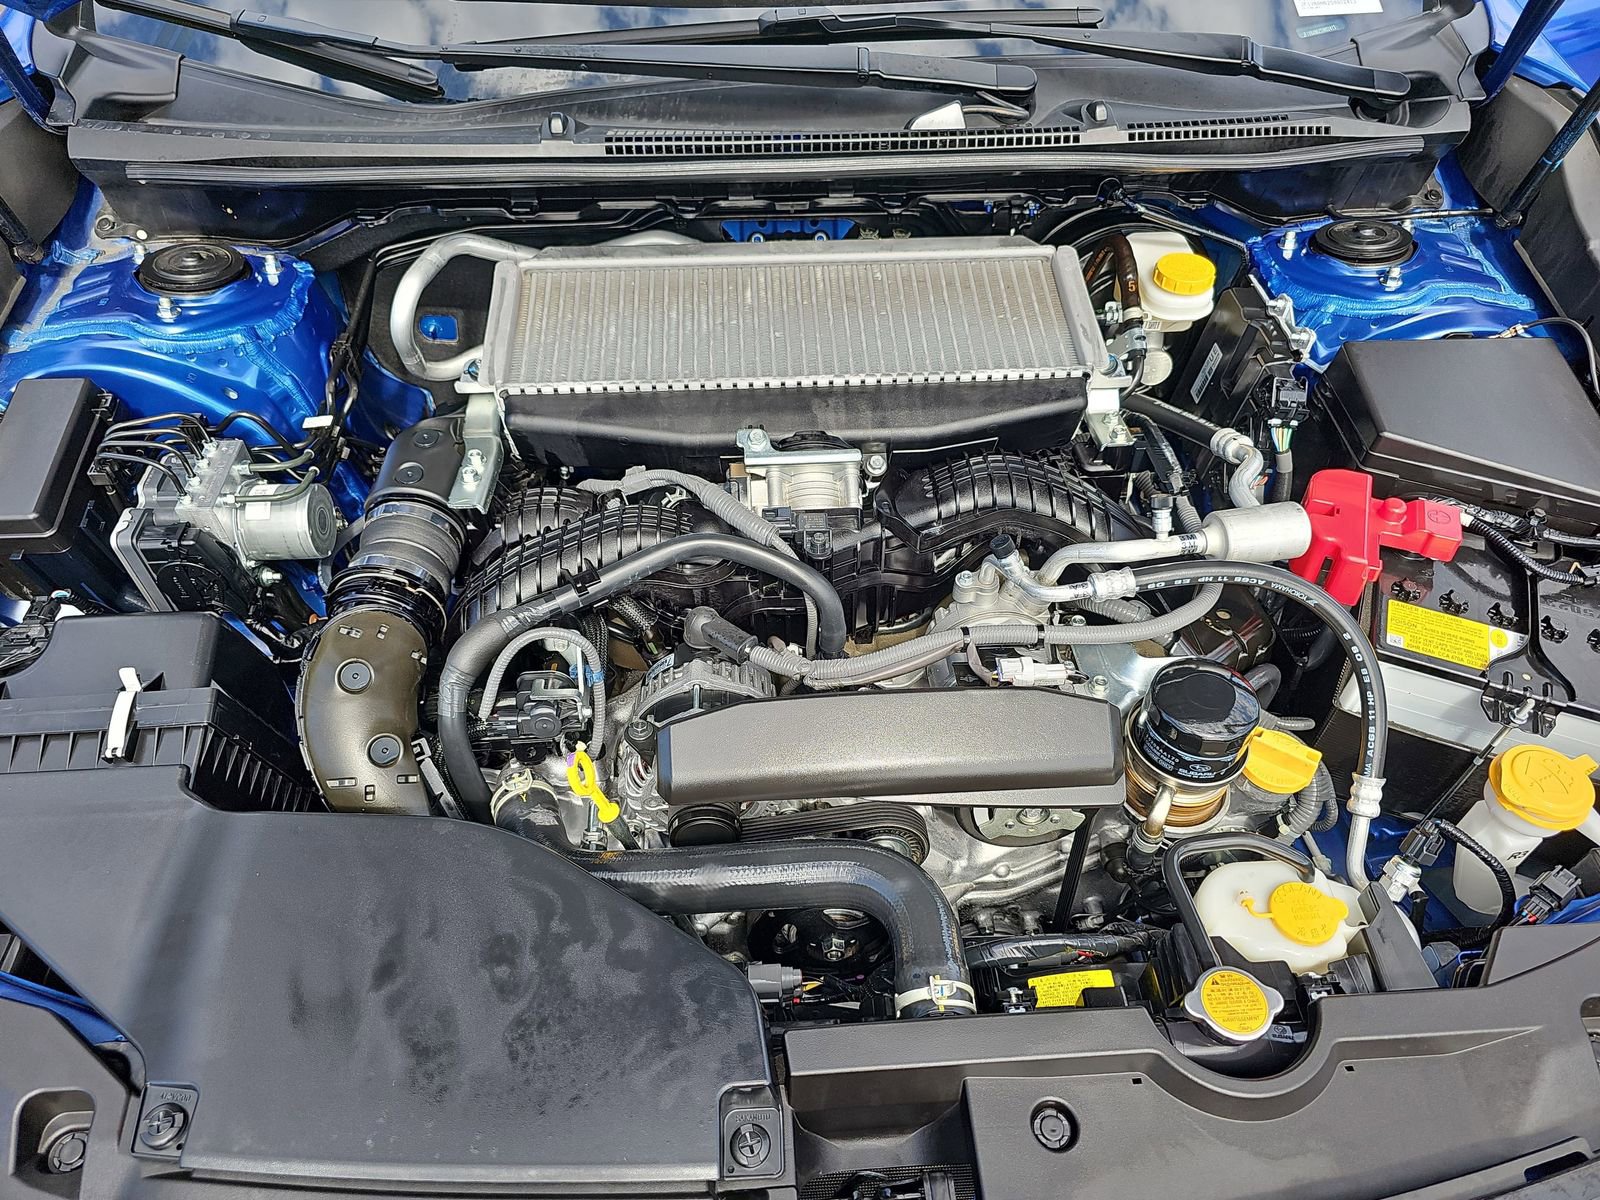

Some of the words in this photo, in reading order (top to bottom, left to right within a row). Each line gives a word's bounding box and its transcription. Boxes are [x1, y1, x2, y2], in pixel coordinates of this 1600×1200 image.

[1128, 281, 1136, 292] 5
[1270, 583, 1310, 602] YOKOHAMA
[1391, 601, 1419, 612] DANGER
[1390, 617, 1417, 628] POISON
[1367, 690, 1376, 706] HP
[1368, 710, 1376, 721] 11
[1178, 768, 1216, 776] SUBARU
